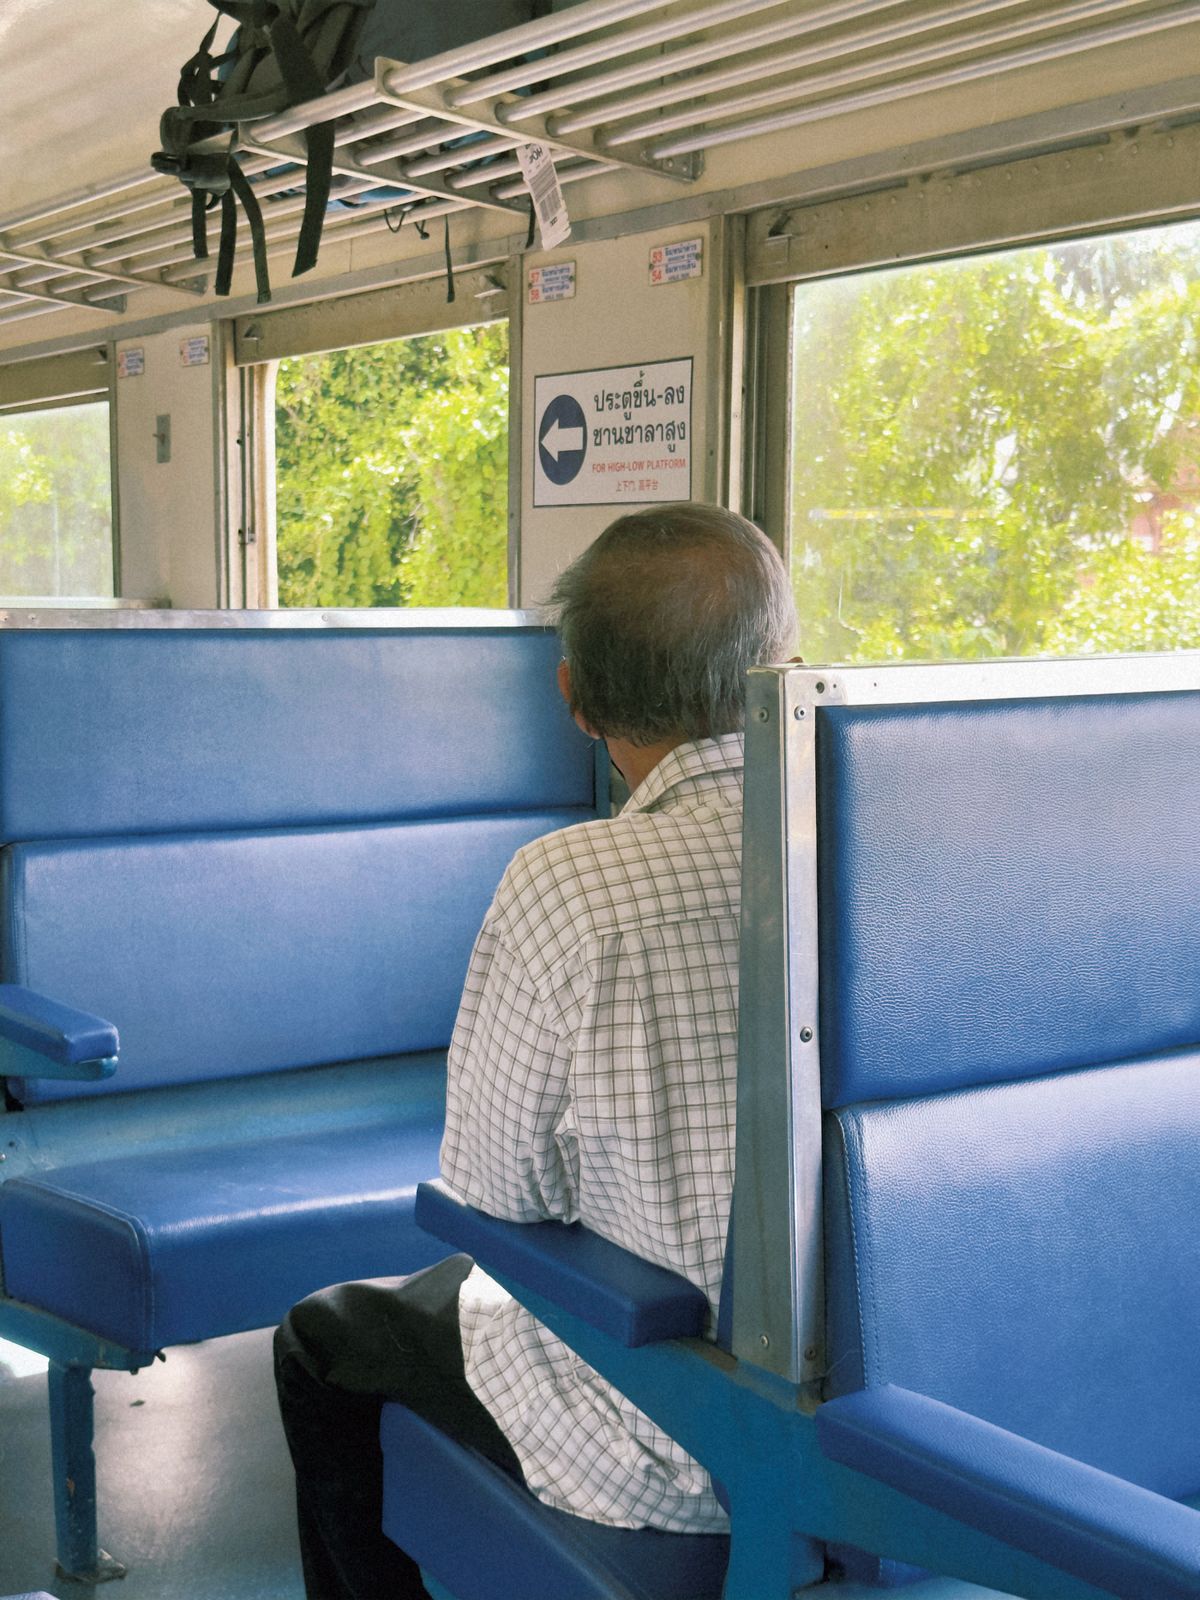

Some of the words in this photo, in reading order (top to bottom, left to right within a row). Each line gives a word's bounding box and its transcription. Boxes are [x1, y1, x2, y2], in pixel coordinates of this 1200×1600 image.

[594, 370, 685, 421] ประตูขึ้น-ลง
[593, 420, 686, 453] ชานชาลาสูง
[592, 463, 606, 474] FOR
[607, 460, 645, 473] HIGH-LOW
[647, 458, 686, 471] PLATFORM
